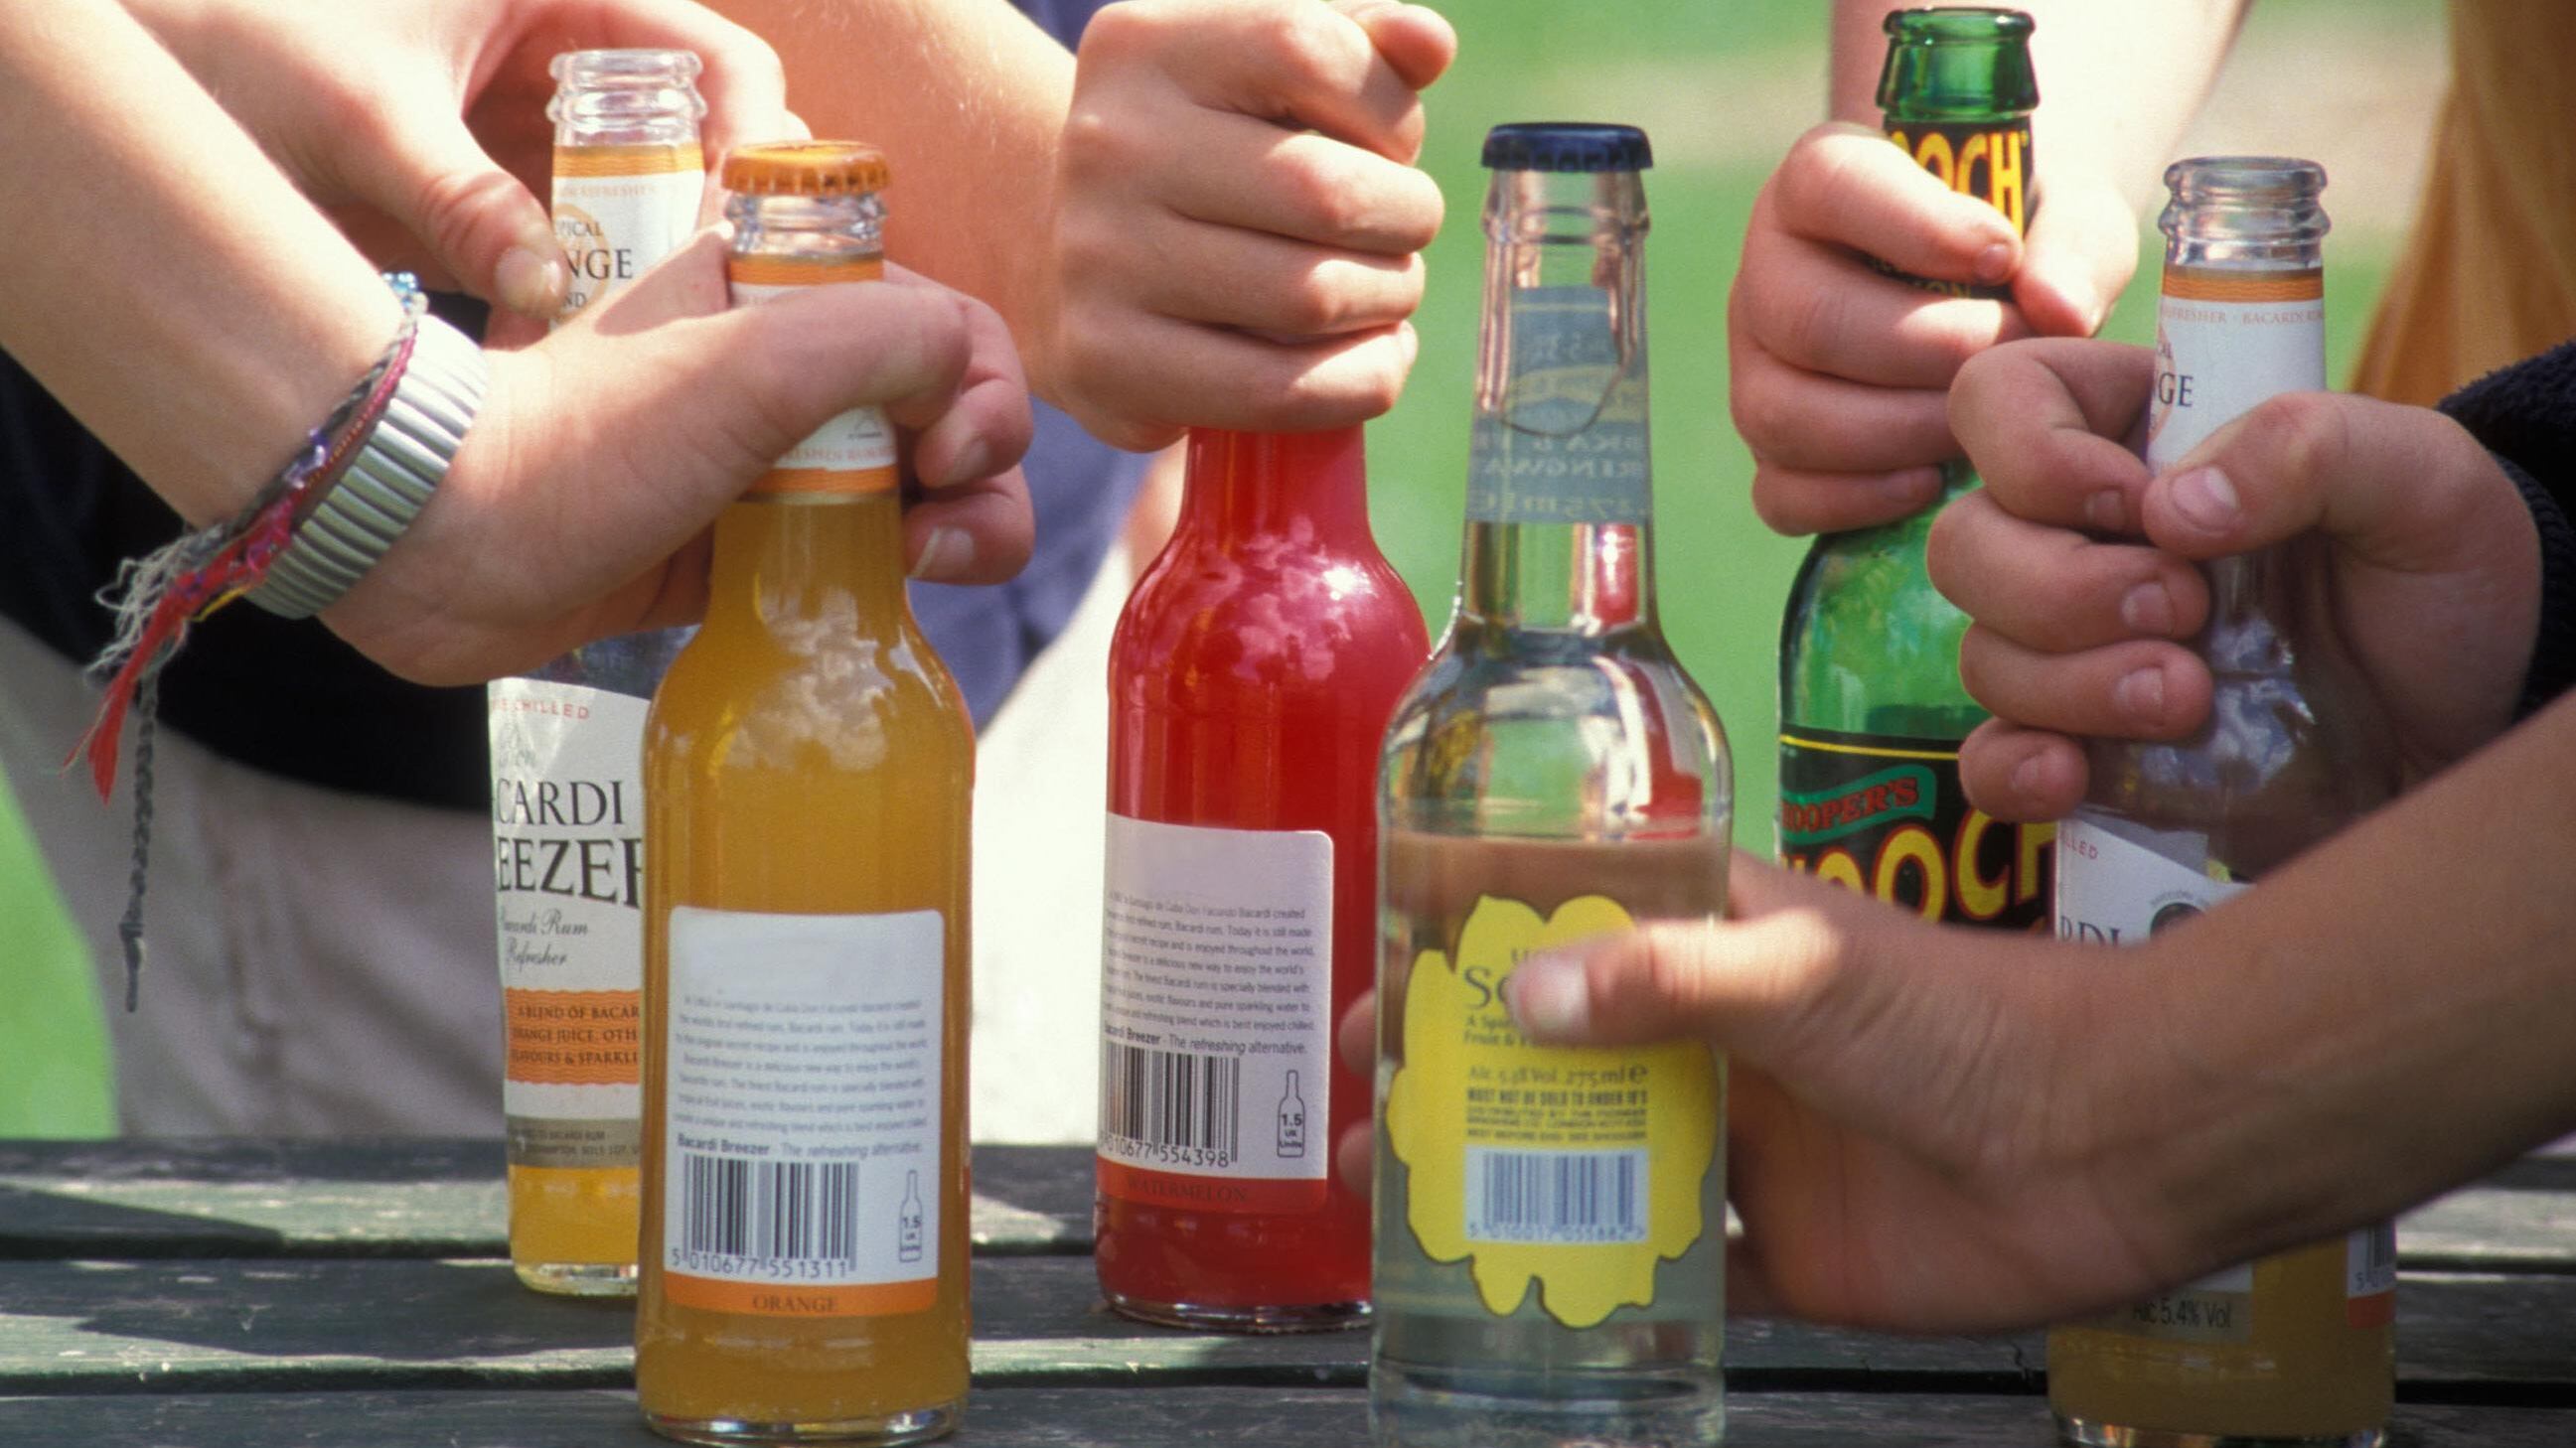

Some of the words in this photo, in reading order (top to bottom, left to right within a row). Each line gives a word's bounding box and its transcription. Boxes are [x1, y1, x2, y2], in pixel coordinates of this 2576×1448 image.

[1891, 130, 2025, 239] OCH
[558, 220, 603, 237] PICAL
[562, 248, 633, 280] NGE
[497, 778, 624, 826] CARDI
[497, 835, 644, 910] EEZE
[591, 1005, 639, 1019] BACAR
[603, 1028, 638, 1042] OTH
[1169, 1032, 1186, 1050] The
[1190, 1038, 1247, 1057] refreshing
[1282, 1113, 1303, 1127] 1.5
[1159, 1144, 1230, 1169] 554398
[902, 1216, 922, 1230] 1.5
[688, 1251, 759, 1275] 010677
[769, 1257, 846, 1278] 551311
[752, 1294, 838, 1313] ORANGE
[2205, 1300, 2233, 1329] Vol
